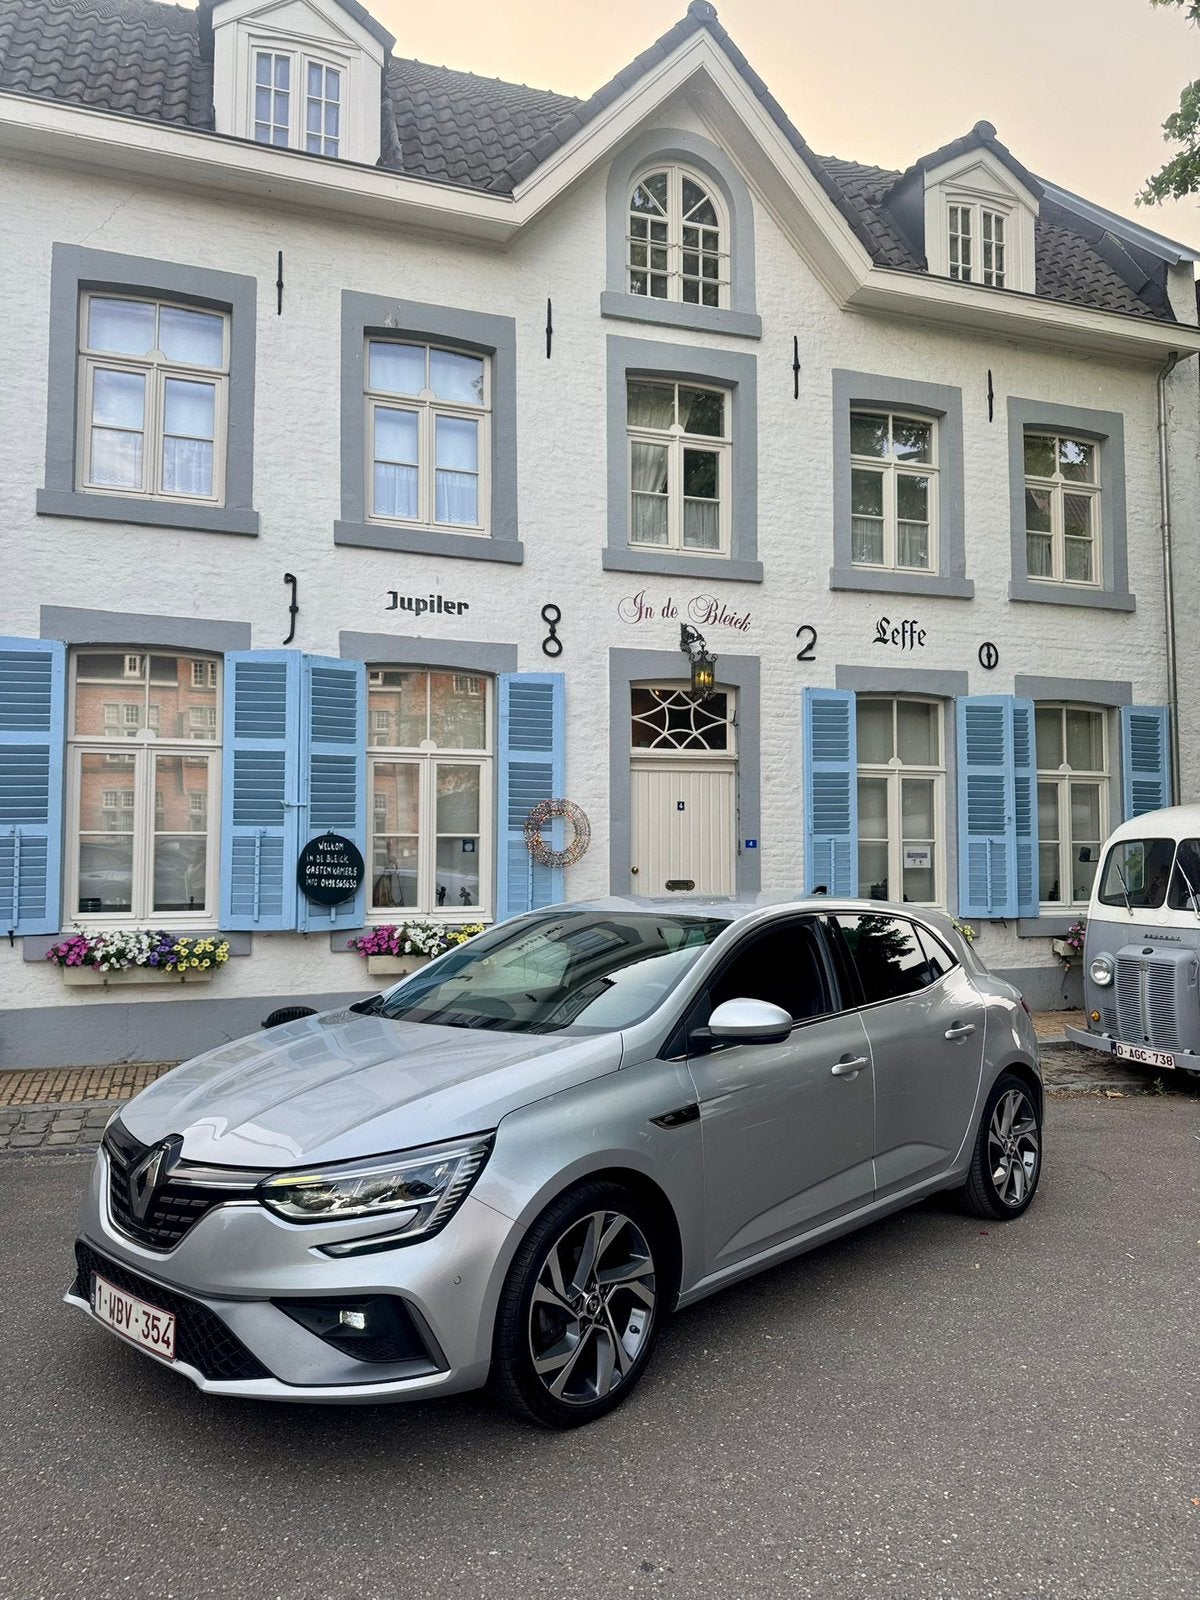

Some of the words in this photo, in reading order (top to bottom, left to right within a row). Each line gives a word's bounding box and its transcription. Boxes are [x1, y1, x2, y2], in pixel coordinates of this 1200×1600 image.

[385, 590, 470, 617] Jupiler
[617, 590, 655, 625] In
[661, 597, 679, 619] de
[687, 594, 751, 633] Bleick
[796, 625, 818, 661] 2
[872, 616, 927, 651] Leffe
[316, 854, 324, 863] DE
[318, 841, 344, 851] WELKOM
